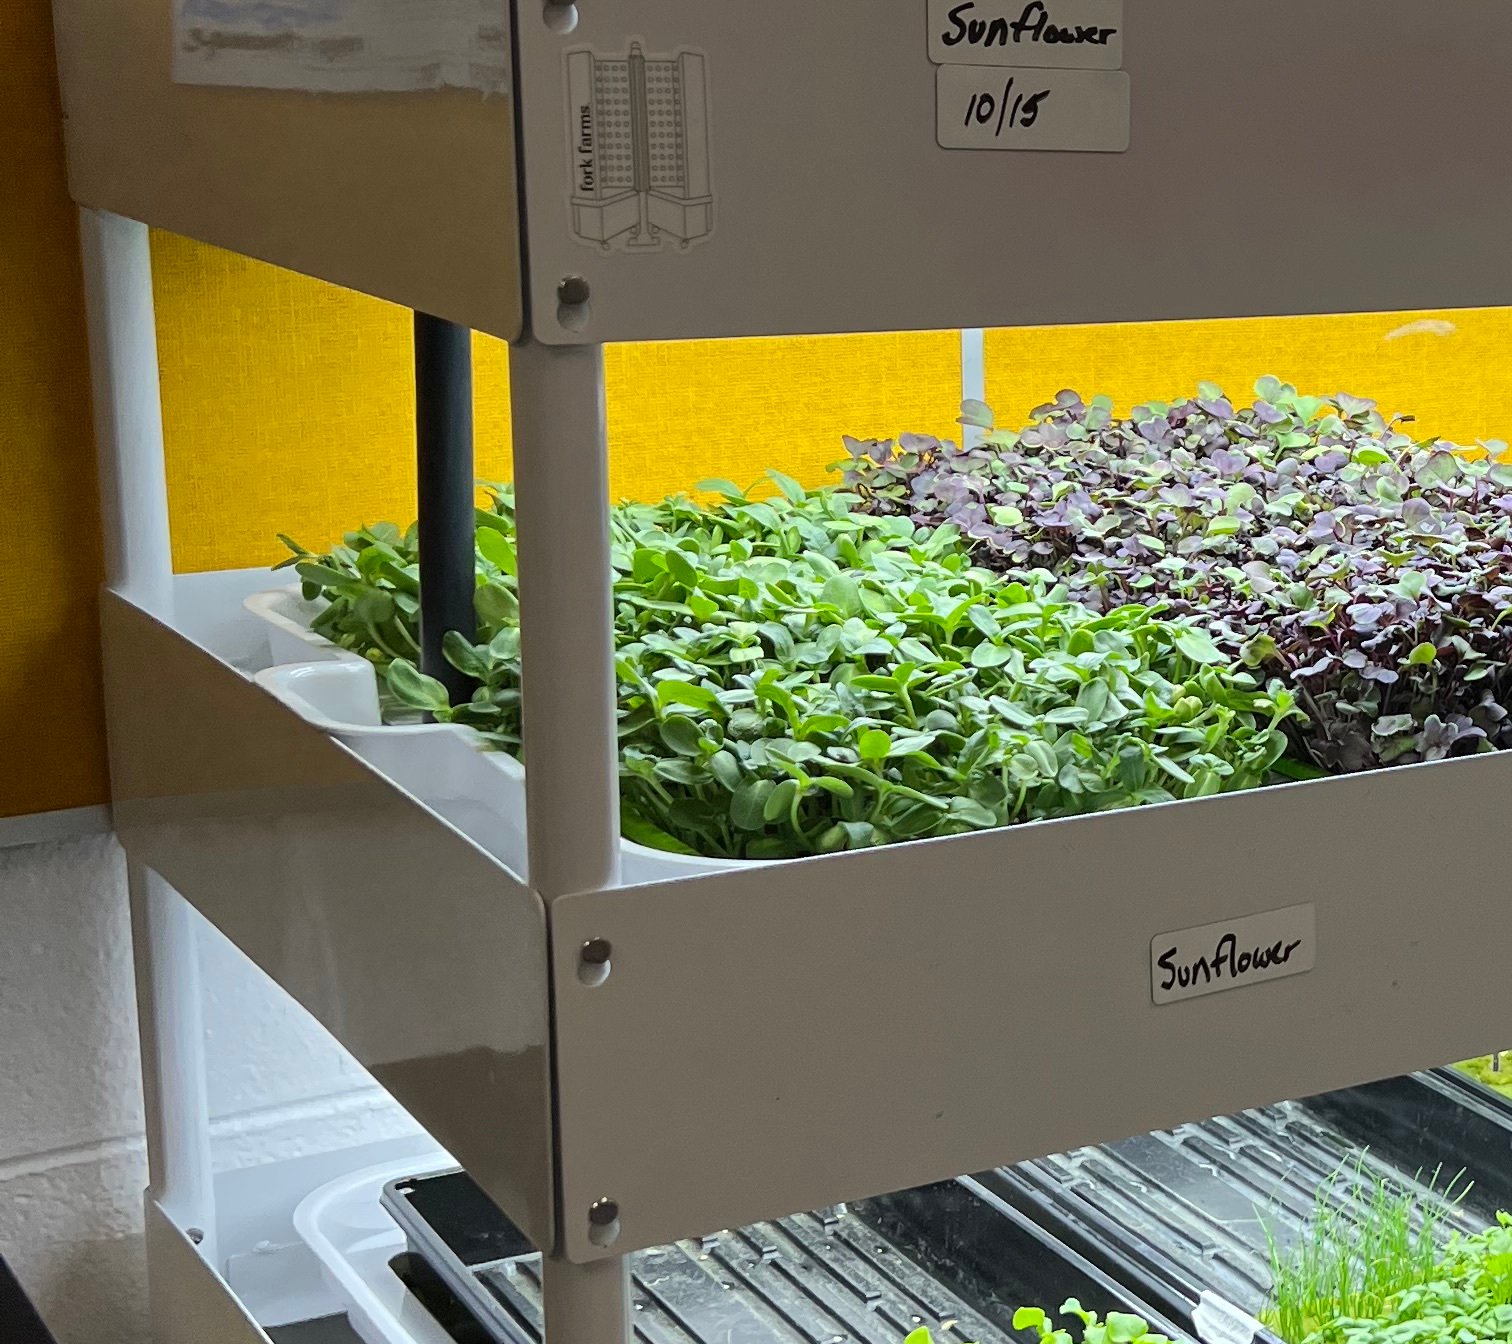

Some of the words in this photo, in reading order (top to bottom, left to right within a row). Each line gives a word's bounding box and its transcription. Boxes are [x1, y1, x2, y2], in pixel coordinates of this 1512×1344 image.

[942, 1, 1117, 46] Sunflower
[578, 106, 592, 154] farms
[964, 77, 1051, 136] 10/15
[579, 159, 594, 191] fork
[1157, 933, 1302, 990] Sunflower
